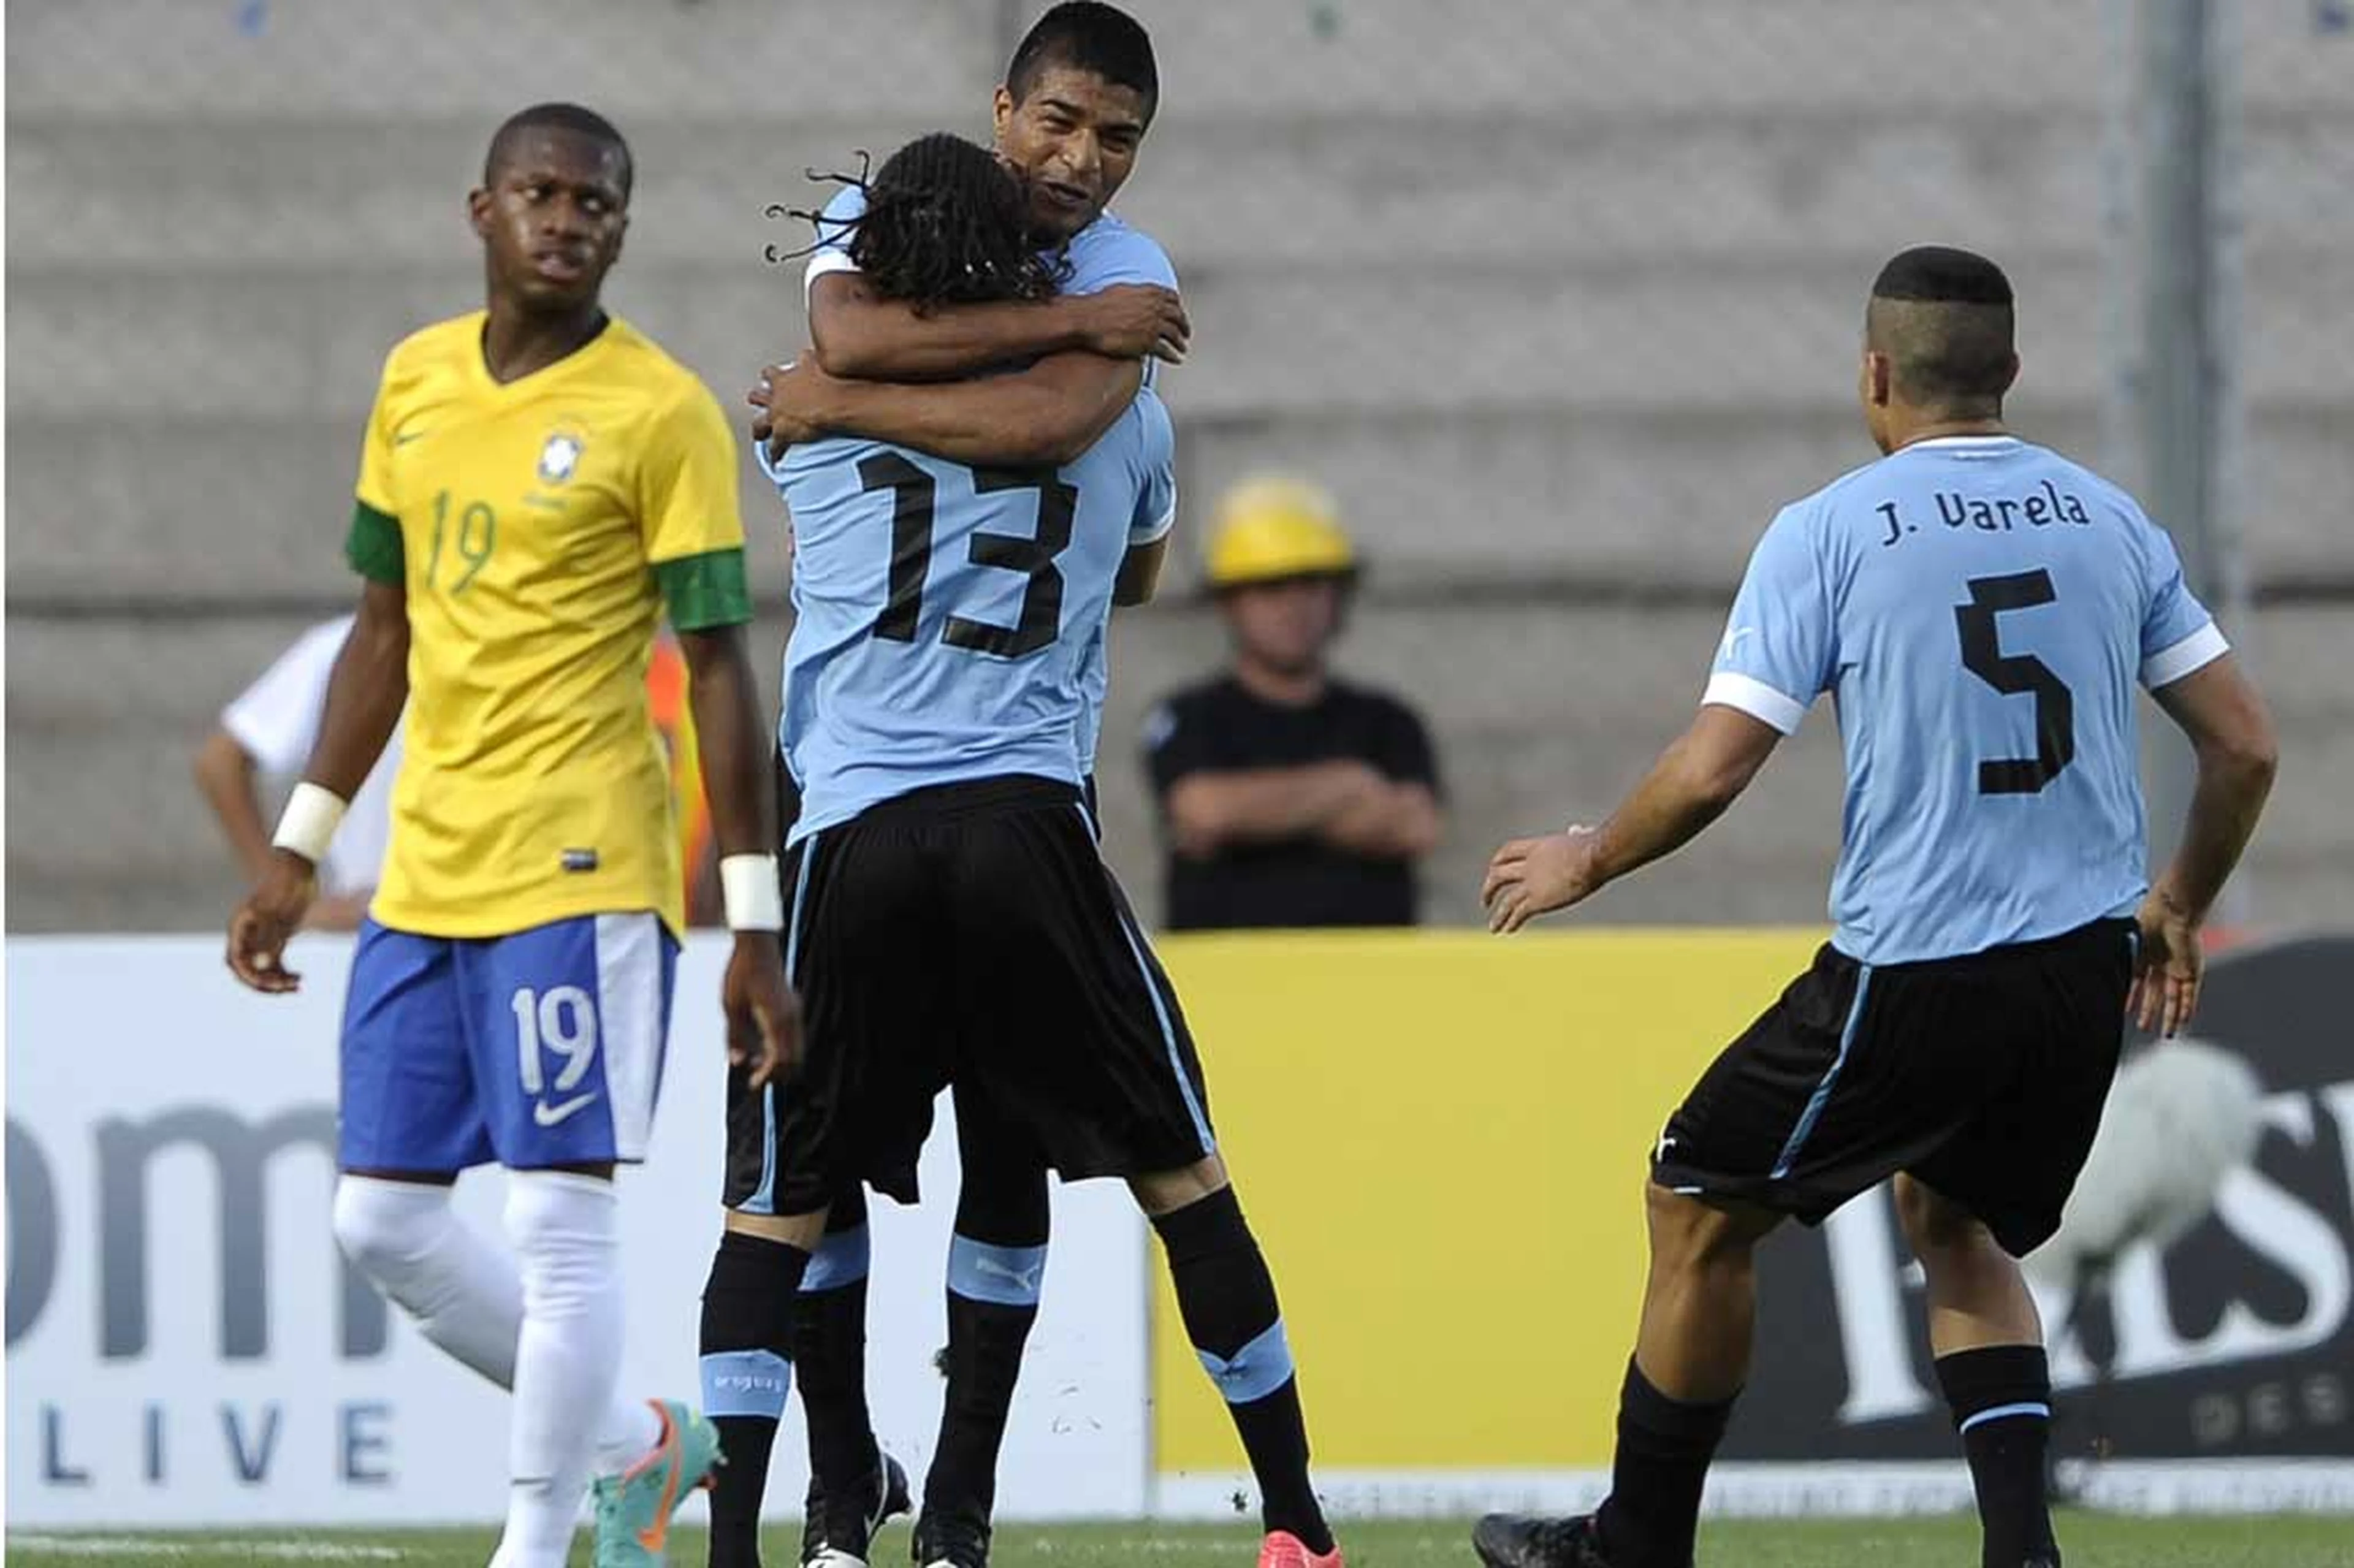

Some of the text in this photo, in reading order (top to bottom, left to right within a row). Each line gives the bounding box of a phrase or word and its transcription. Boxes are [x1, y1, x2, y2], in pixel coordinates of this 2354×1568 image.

[424, 490, 497, 596] 19
[857, 452, 1079, 660] 13
[1876, 502, 1918, 547] J.
[1954, 566, 2074, 795] 5
[511, 986, 597, 1095] 19
[40, 1402, 391, 1485] LIVE
